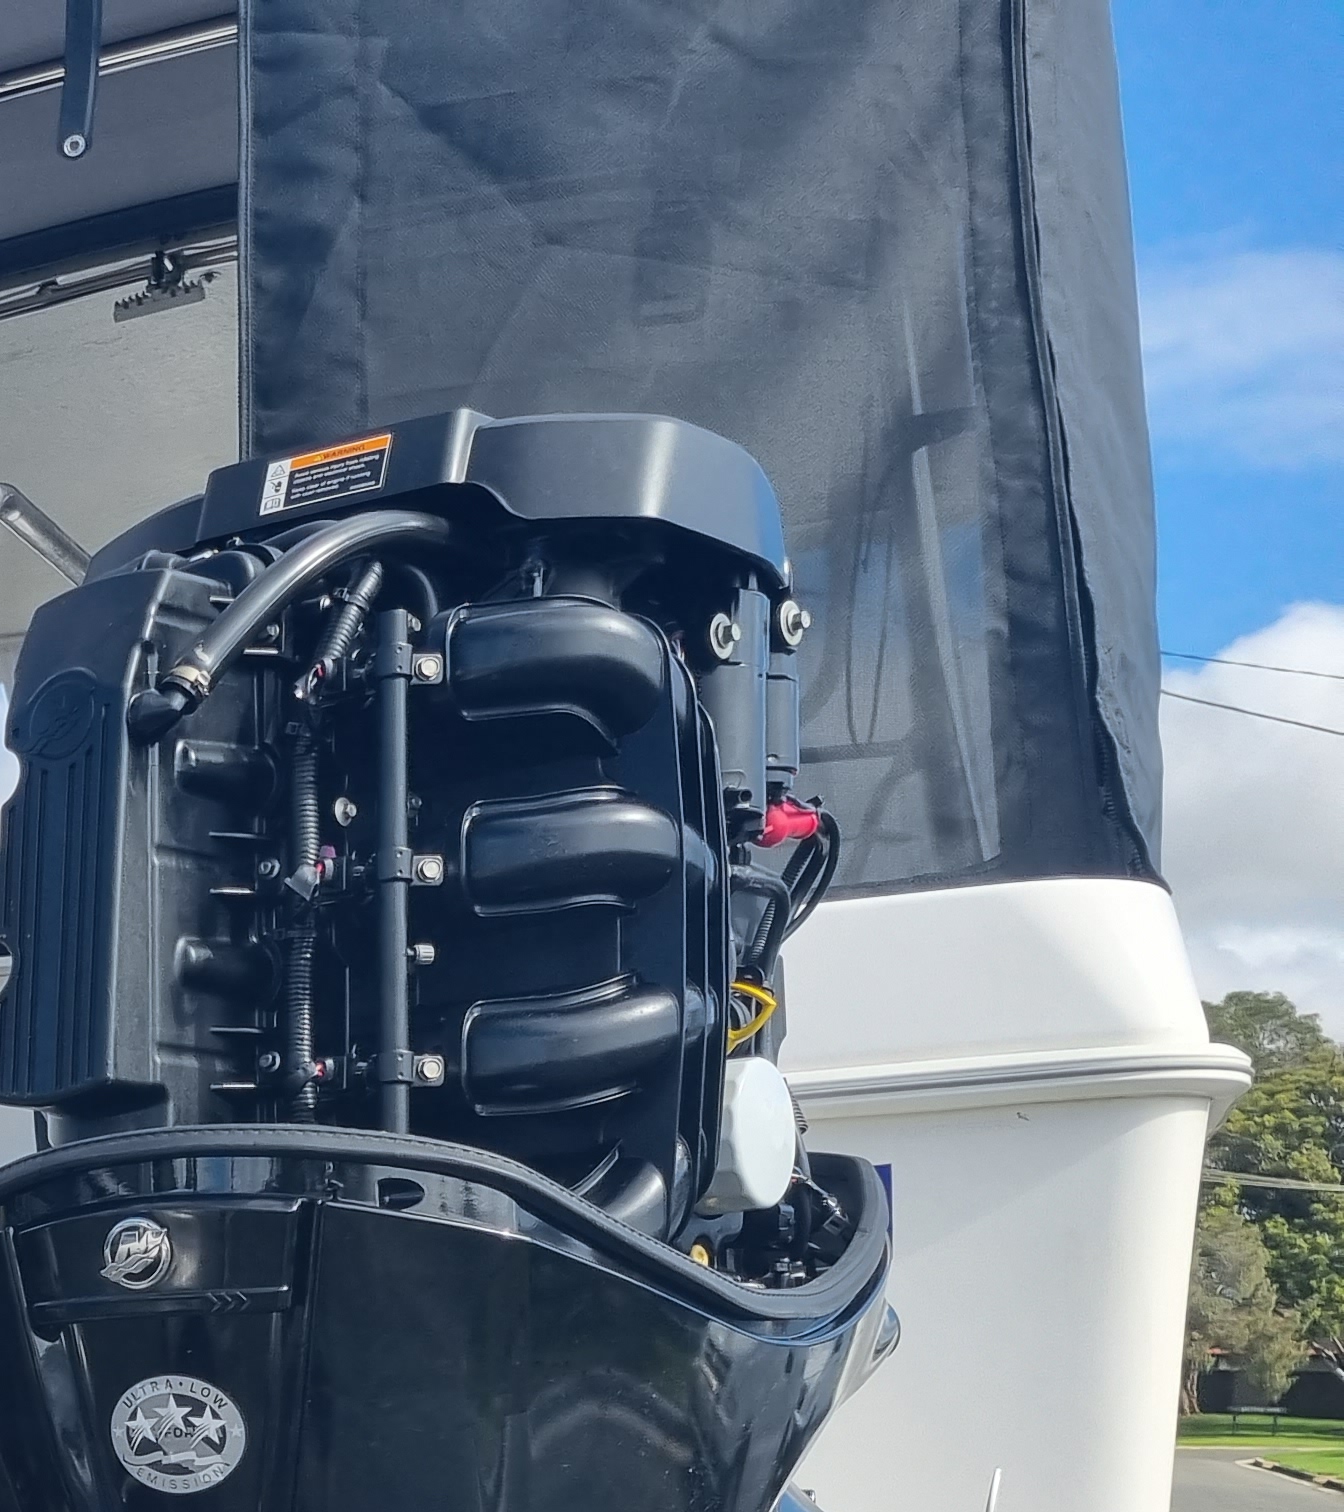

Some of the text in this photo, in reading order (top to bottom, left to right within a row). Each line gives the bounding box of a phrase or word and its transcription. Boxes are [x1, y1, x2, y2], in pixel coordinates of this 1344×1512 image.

[122, 1378, 228, 1409] ULTRA LOW
[136, 1467, 224, 1489] EMISSION
